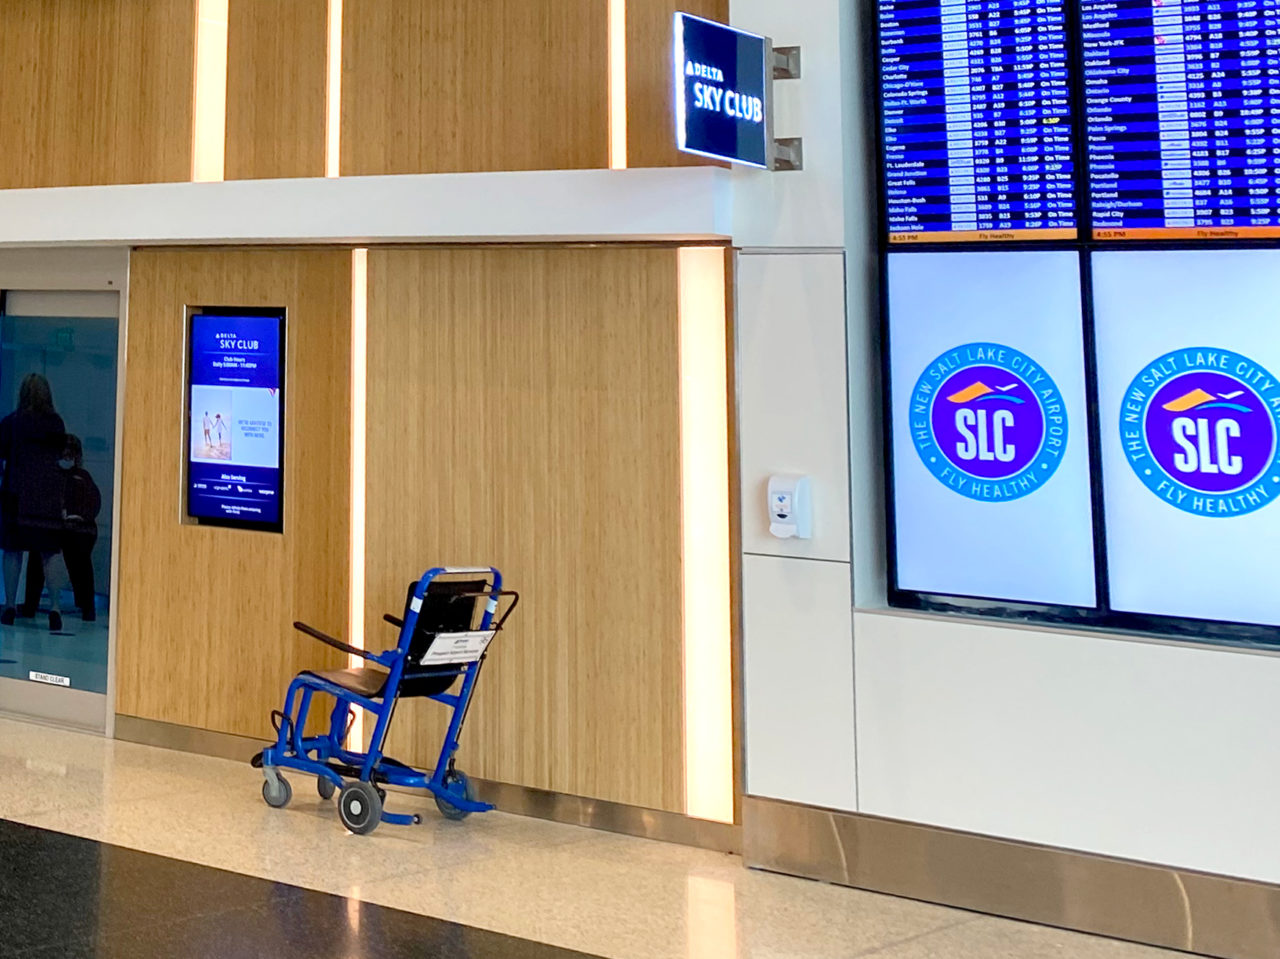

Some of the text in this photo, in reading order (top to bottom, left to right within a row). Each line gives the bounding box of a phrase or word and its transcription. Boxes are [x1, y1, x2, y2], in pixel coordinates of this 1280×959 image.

[1046, 5, 1061, 13] Time
[694, 63, 724, 82] DELTA
[694, 82, 763, 123] SKY CLUB
[1109, 95, 1131, 103] County
[220, 339, 259, 350] SKY CLUB
[914, 348, 1064, 458] THE NEW SALT LAKE CITY AIRPORT
[1124, 352, 1276, 462] THE NEW SALT LAKE CITY
[955, 408, 1016, 463] SLC
[1171, 417, 1243, 476] SLC
[940, 467, 1039, 499] FLY HEALTHY
[1156, 480, 1272, 514] FLY HEALTHY
